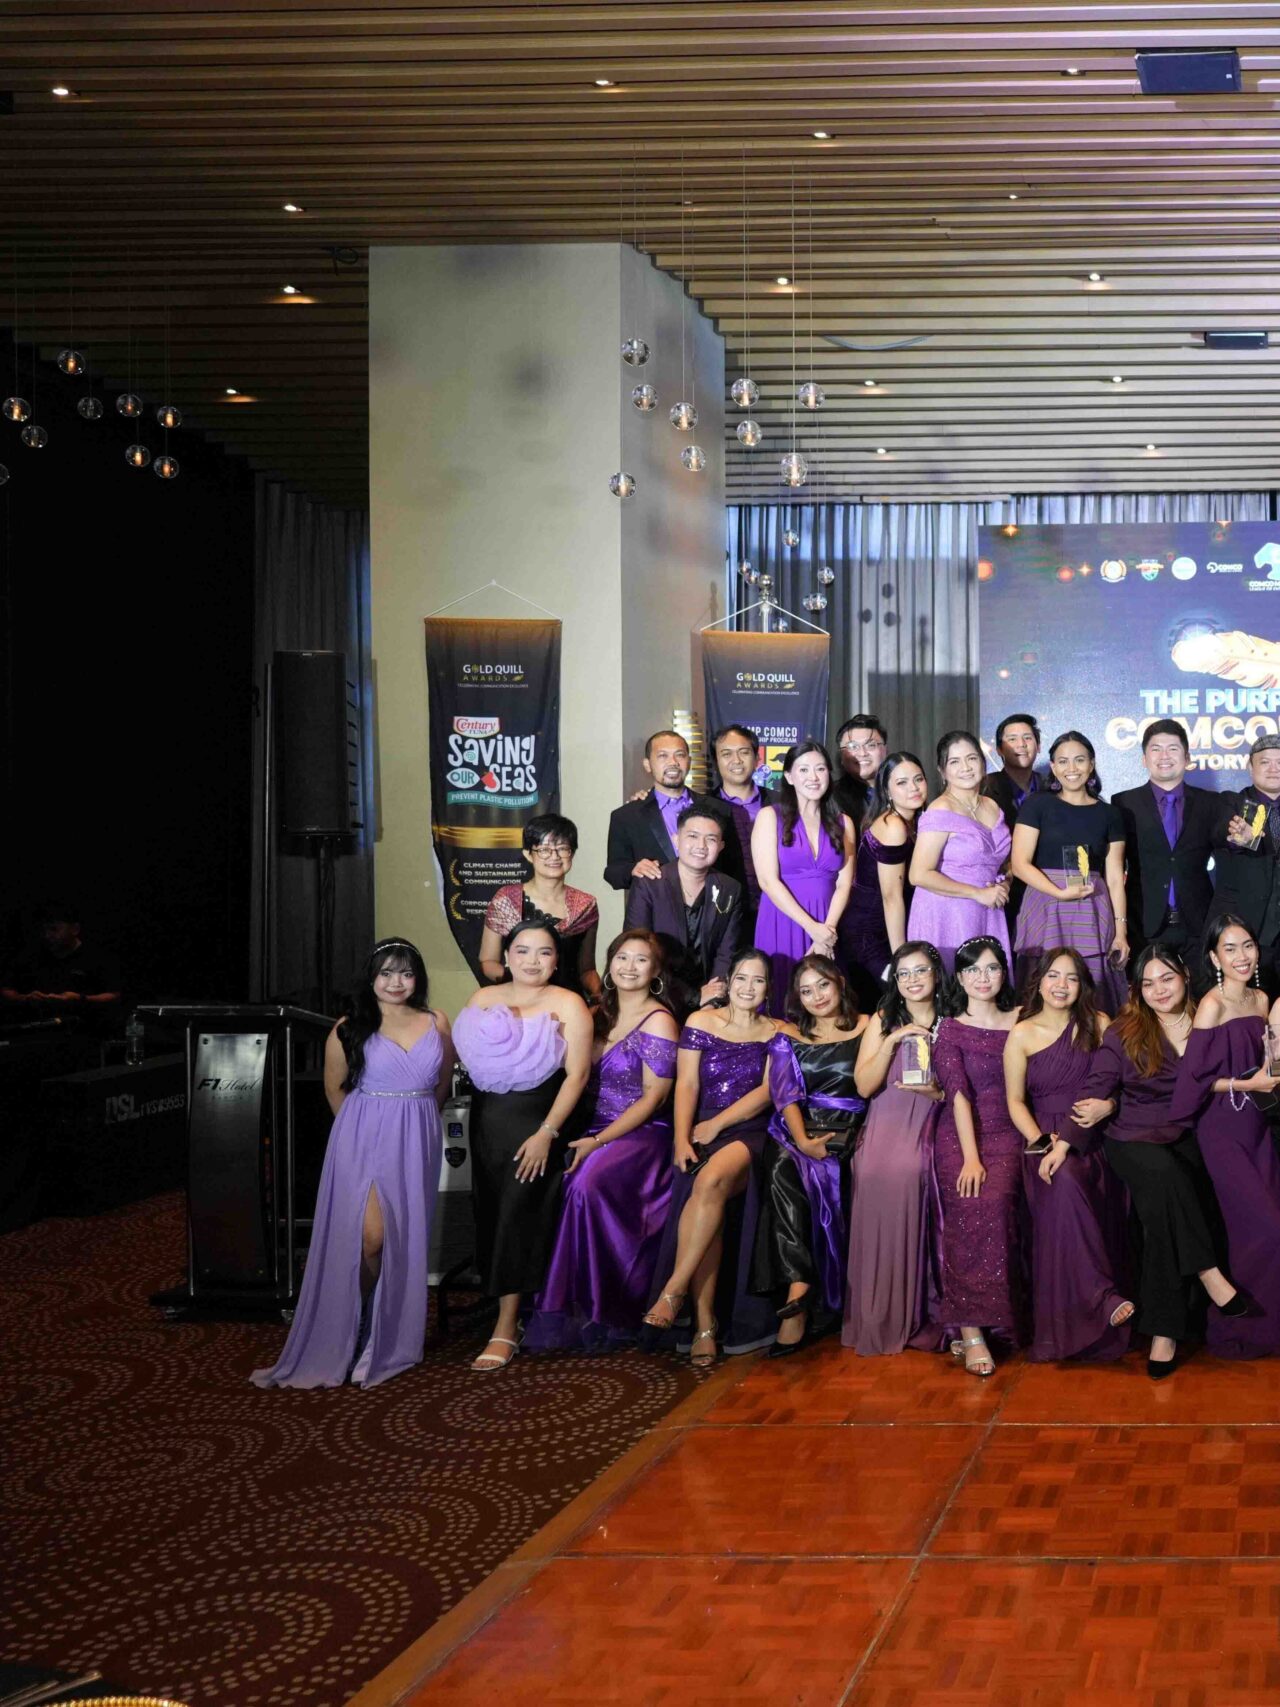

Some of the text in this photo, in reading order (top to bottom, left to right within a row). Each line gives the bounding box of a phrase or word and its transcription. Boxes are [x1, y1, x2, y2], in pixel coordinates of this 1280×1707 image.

[462, 664, 524, 675] GOLD QUILL
[463, 674, 508, 682] AWARDS
[736, 672, 796, 683] GOLD QUILL
[1139, 688, 1199, 714] THE
[456, 718, 496, 732] Century
[764, 726, 798, 738] COMCO
[450, 770, 474, 784] OUR
[452, 792, 534, 805] PREVENT PLASTIC POLLUTION
[197, 1077, 261, 1090] F1 Hotel
